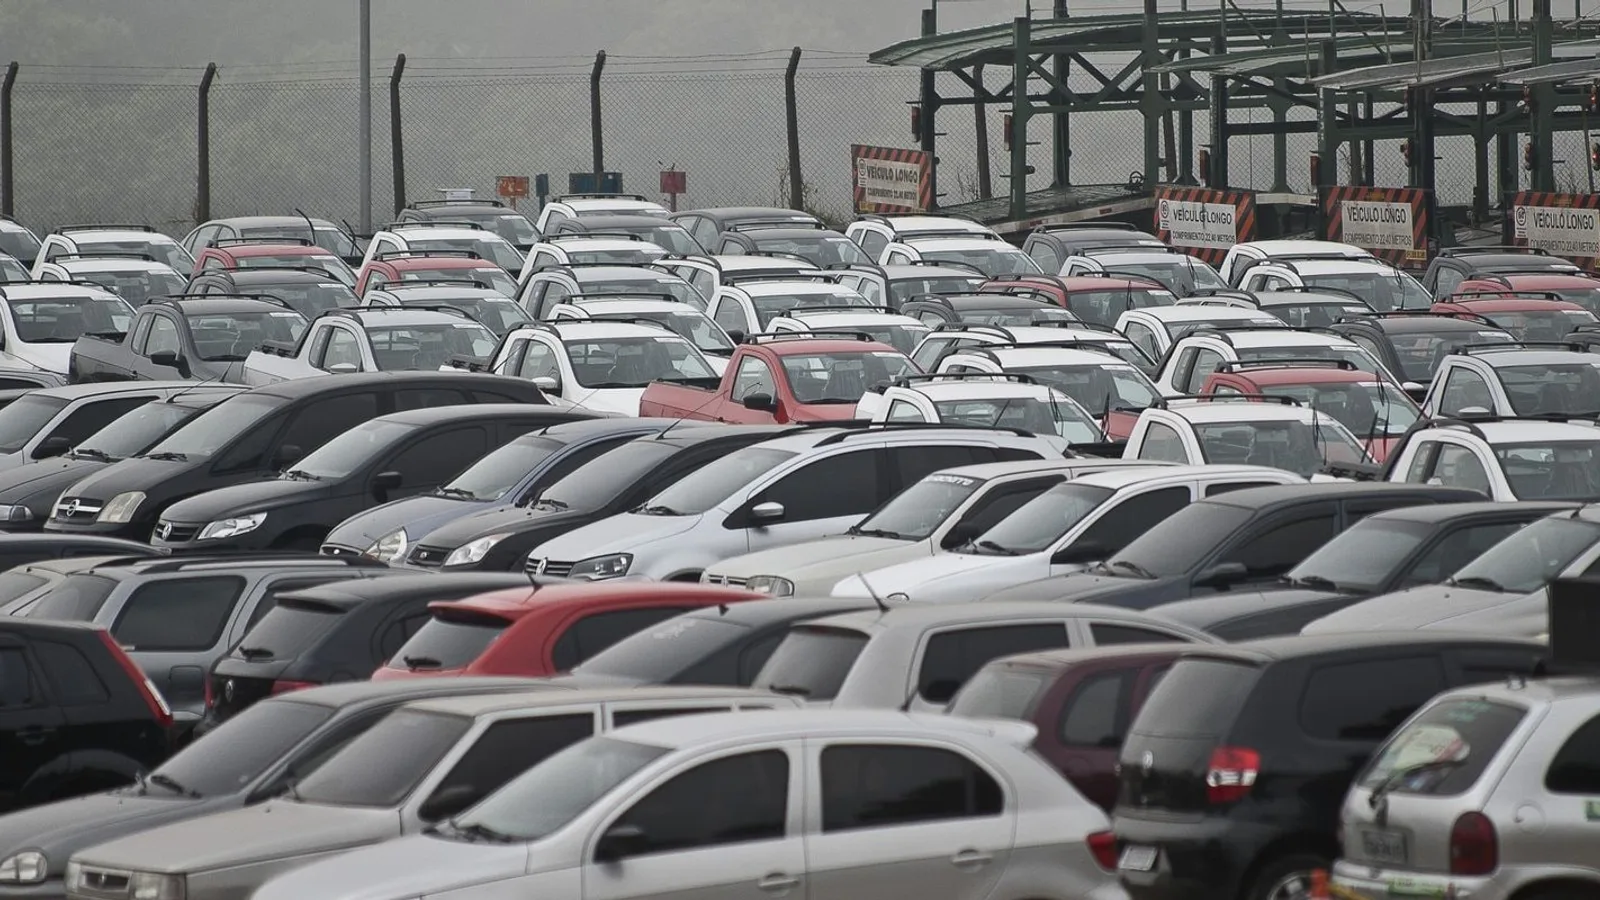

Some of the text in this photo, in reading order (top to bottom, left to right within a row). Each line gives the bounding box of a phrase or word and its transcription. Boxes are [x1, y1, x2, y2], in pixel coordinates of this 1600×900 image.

[895, 168, 918, 184] LONGO
[1206, 210, 1232, 225] LONGO
[1380, 207, 1406, 224] LONGO
[1567, 213, 1595, 230] LONGO
